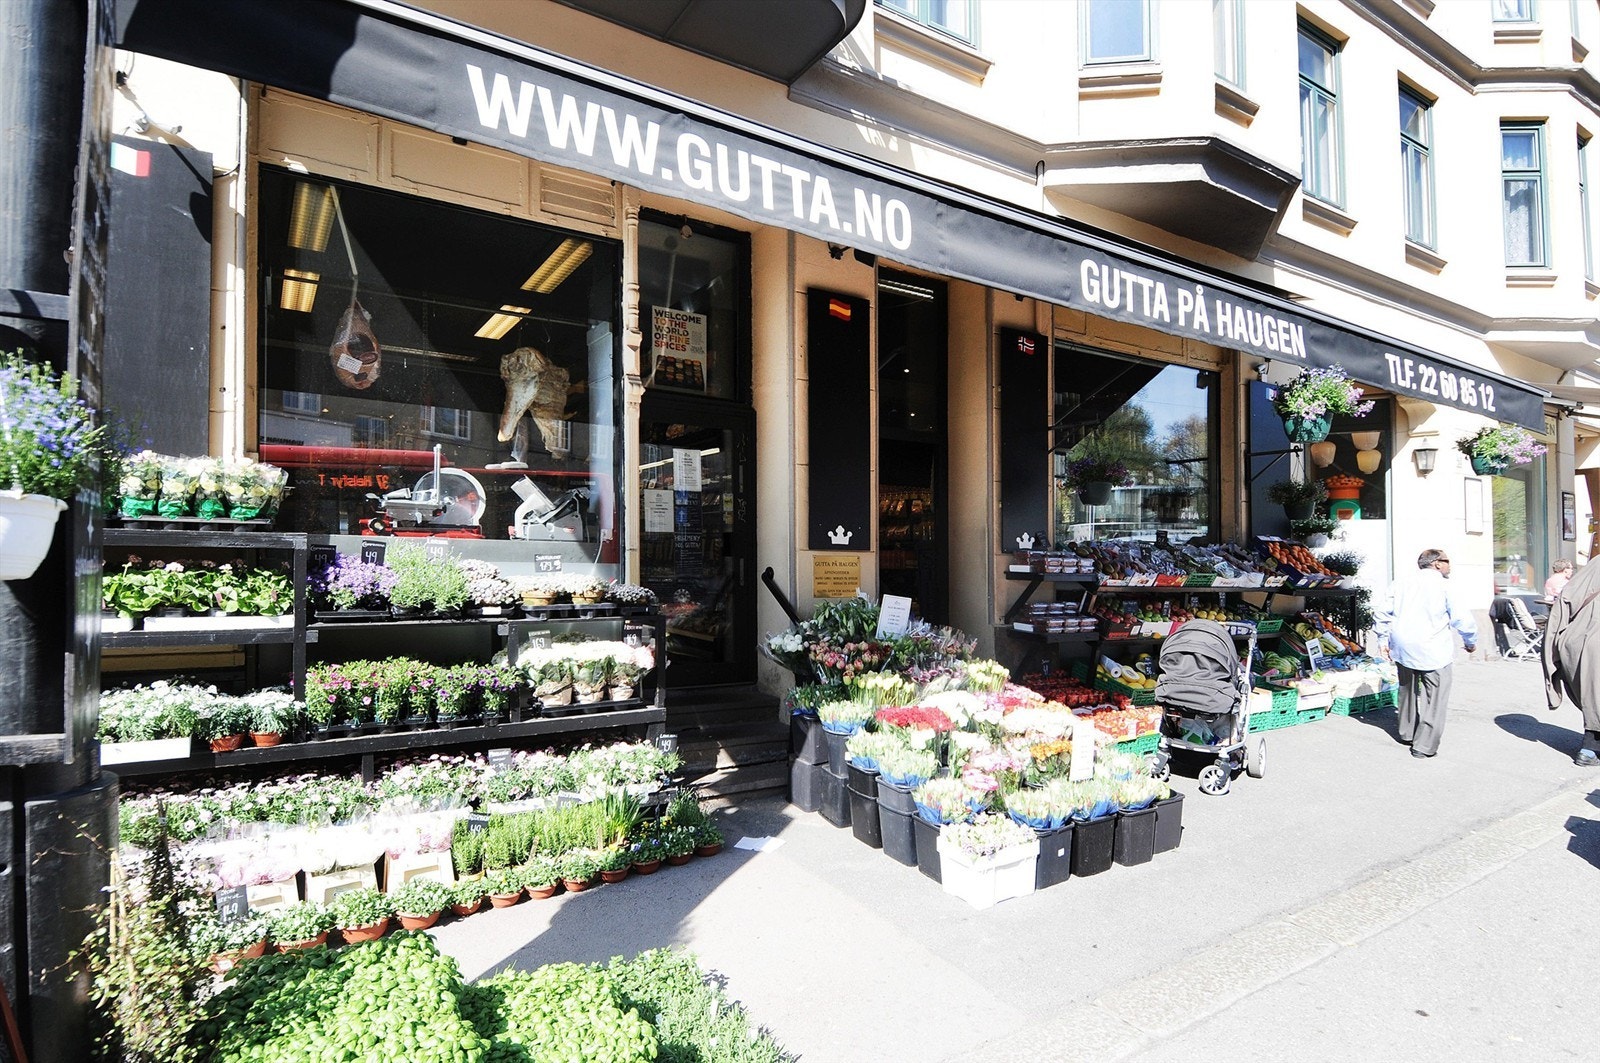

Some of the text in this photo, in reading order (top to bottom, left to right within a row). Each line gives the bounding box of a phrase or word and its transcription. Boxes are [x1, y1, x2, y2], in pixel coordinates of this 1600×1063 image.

[466, 64, 912, 250] WWW.GUTTA.NO
[1080, 259, 1306, 358] GUTTA PÅ HAUGEN
[654, 309, 701, 324] WELCOME
[654, 317, 687, 329] TO THE
[654, 324, 689, 336] WORLD
[654, 340, 686, 352] SPICES
[670, 335, 690, 345] FINE
[1385, 352, 1496, 412] TLF. 22 60 85 12
[366, 551, 378, 564] 49
[430, 546, 444, 558] 49
[314, 554, 328, 564] 49
[661, 740, 672, 752] 49
[470, 824, 482, 833] 49
